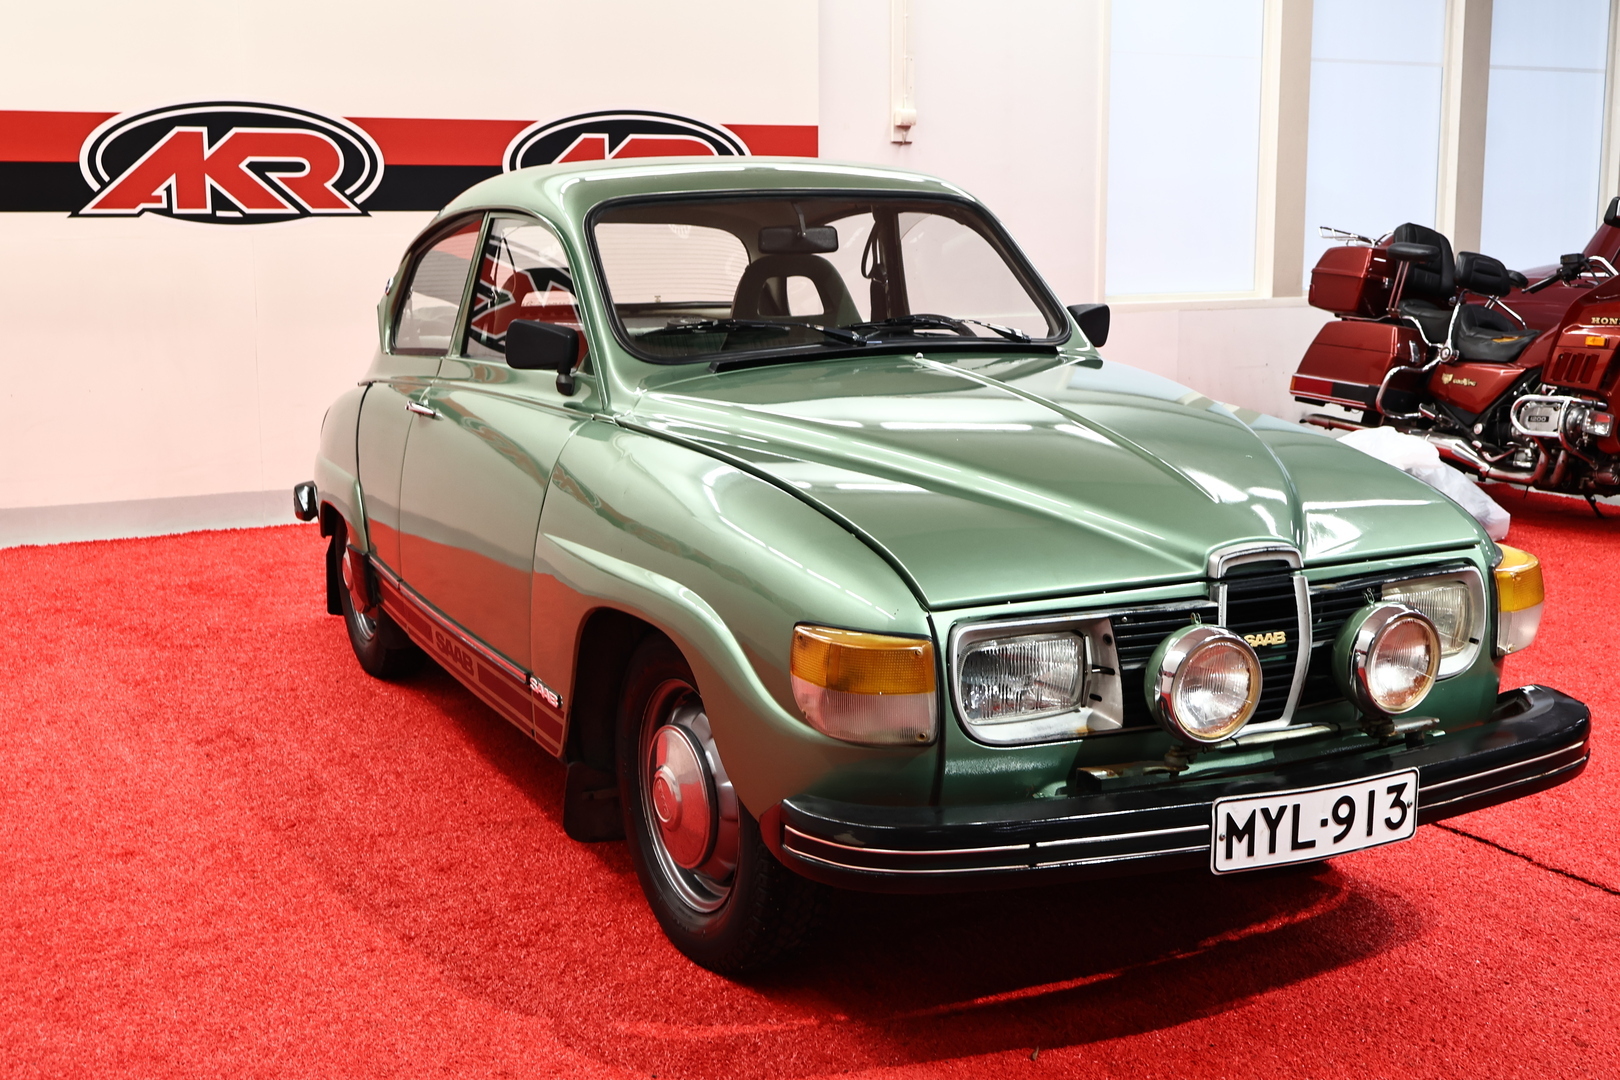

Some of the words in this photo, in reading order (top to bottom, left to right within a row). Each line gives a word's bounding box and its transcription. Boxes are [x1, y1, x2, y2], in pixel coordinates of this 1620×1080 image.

[78, 126, 363, 215] AKR
[1591, 317, 1620, 325] HON
[435, 630, 475, 677] SAAB
[1243, 631, 1286, 648] SAAB
[530, 677, 559, 708] SAAB
